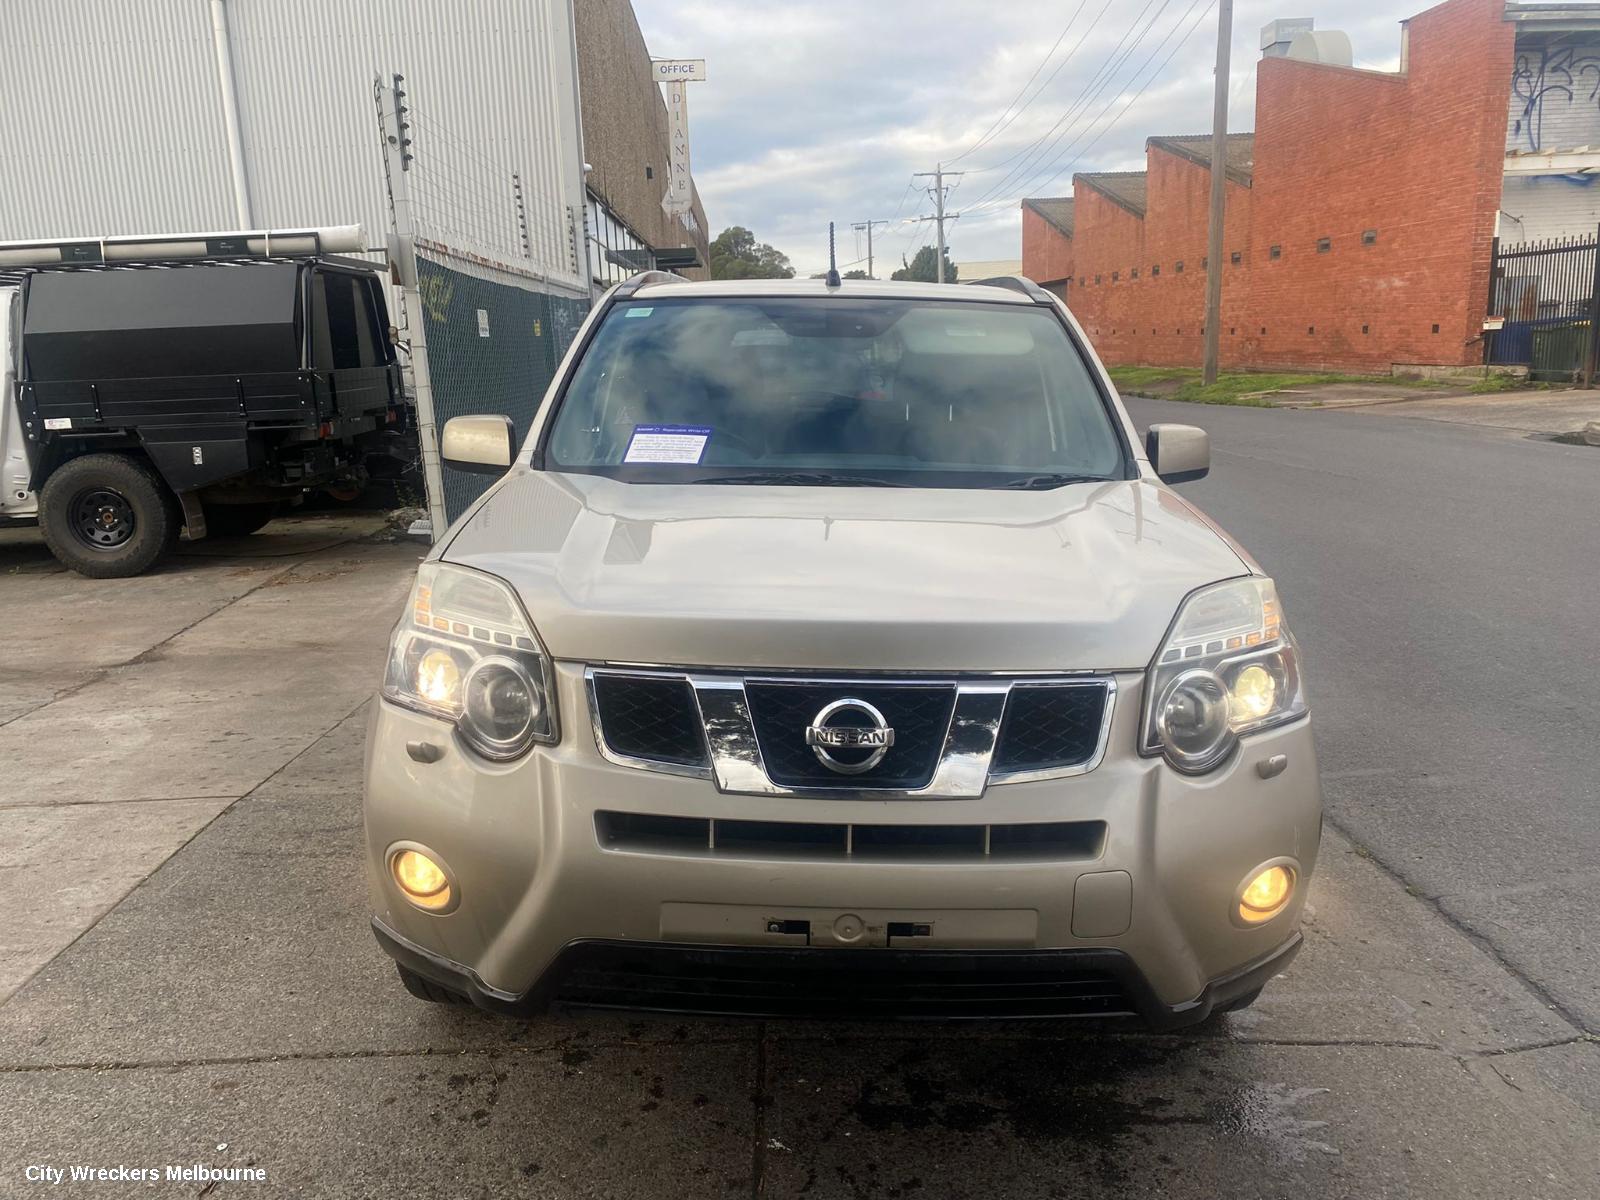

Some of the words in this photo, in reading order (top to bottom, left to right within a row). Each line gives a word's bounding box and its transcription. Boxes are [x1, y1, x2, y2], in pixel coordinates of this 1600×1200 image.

[660, 64, 695, 73] OFFICE
[672, 93, 686, 190] DIANNE
[815, 732, 885, 744] NISSAN
